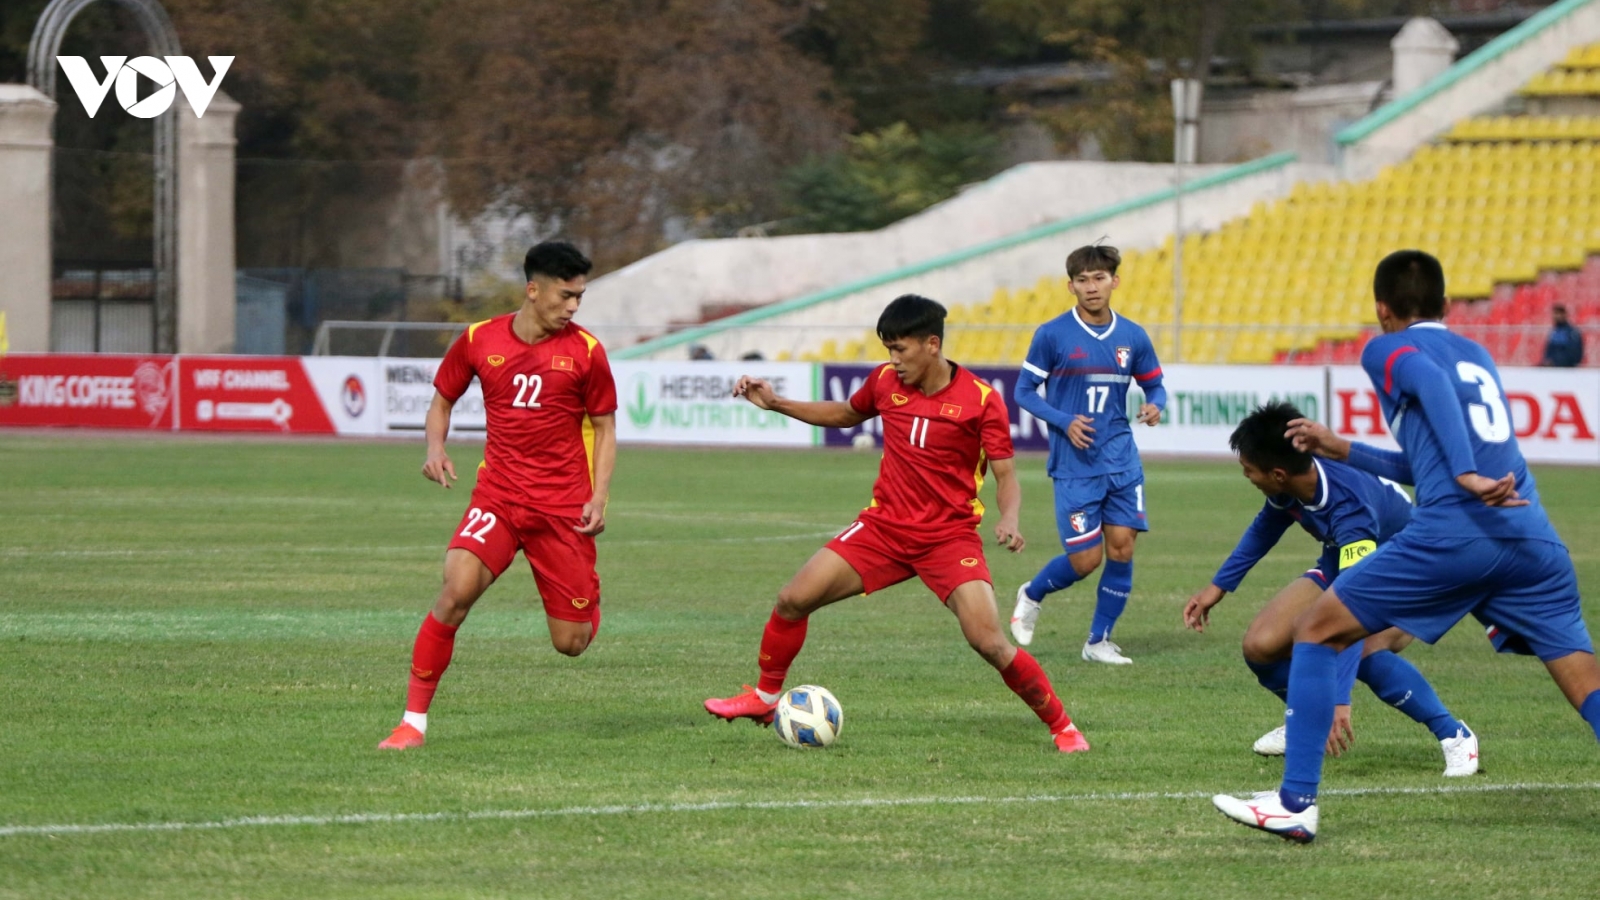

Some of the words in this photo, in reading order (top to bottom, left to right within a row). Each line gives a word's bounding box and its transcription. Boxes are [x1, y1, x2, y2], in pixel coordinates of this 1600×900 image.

[19, 374, 64, 406] KING
[66, 375, 136, 408] COFFEE
[222, 369, 290, 391] CHANNEL
[512, 373, 543, 408] 22
[660, 404, 788, 429] NUTRITION
[1086, 386, 1109, 413] 17
[1337, 390, 1595, 440] HDA
[1456, 361, 1510, 443] 3
[910, 416, 929, 448] 11
[460, 507, 496, 543] 22
